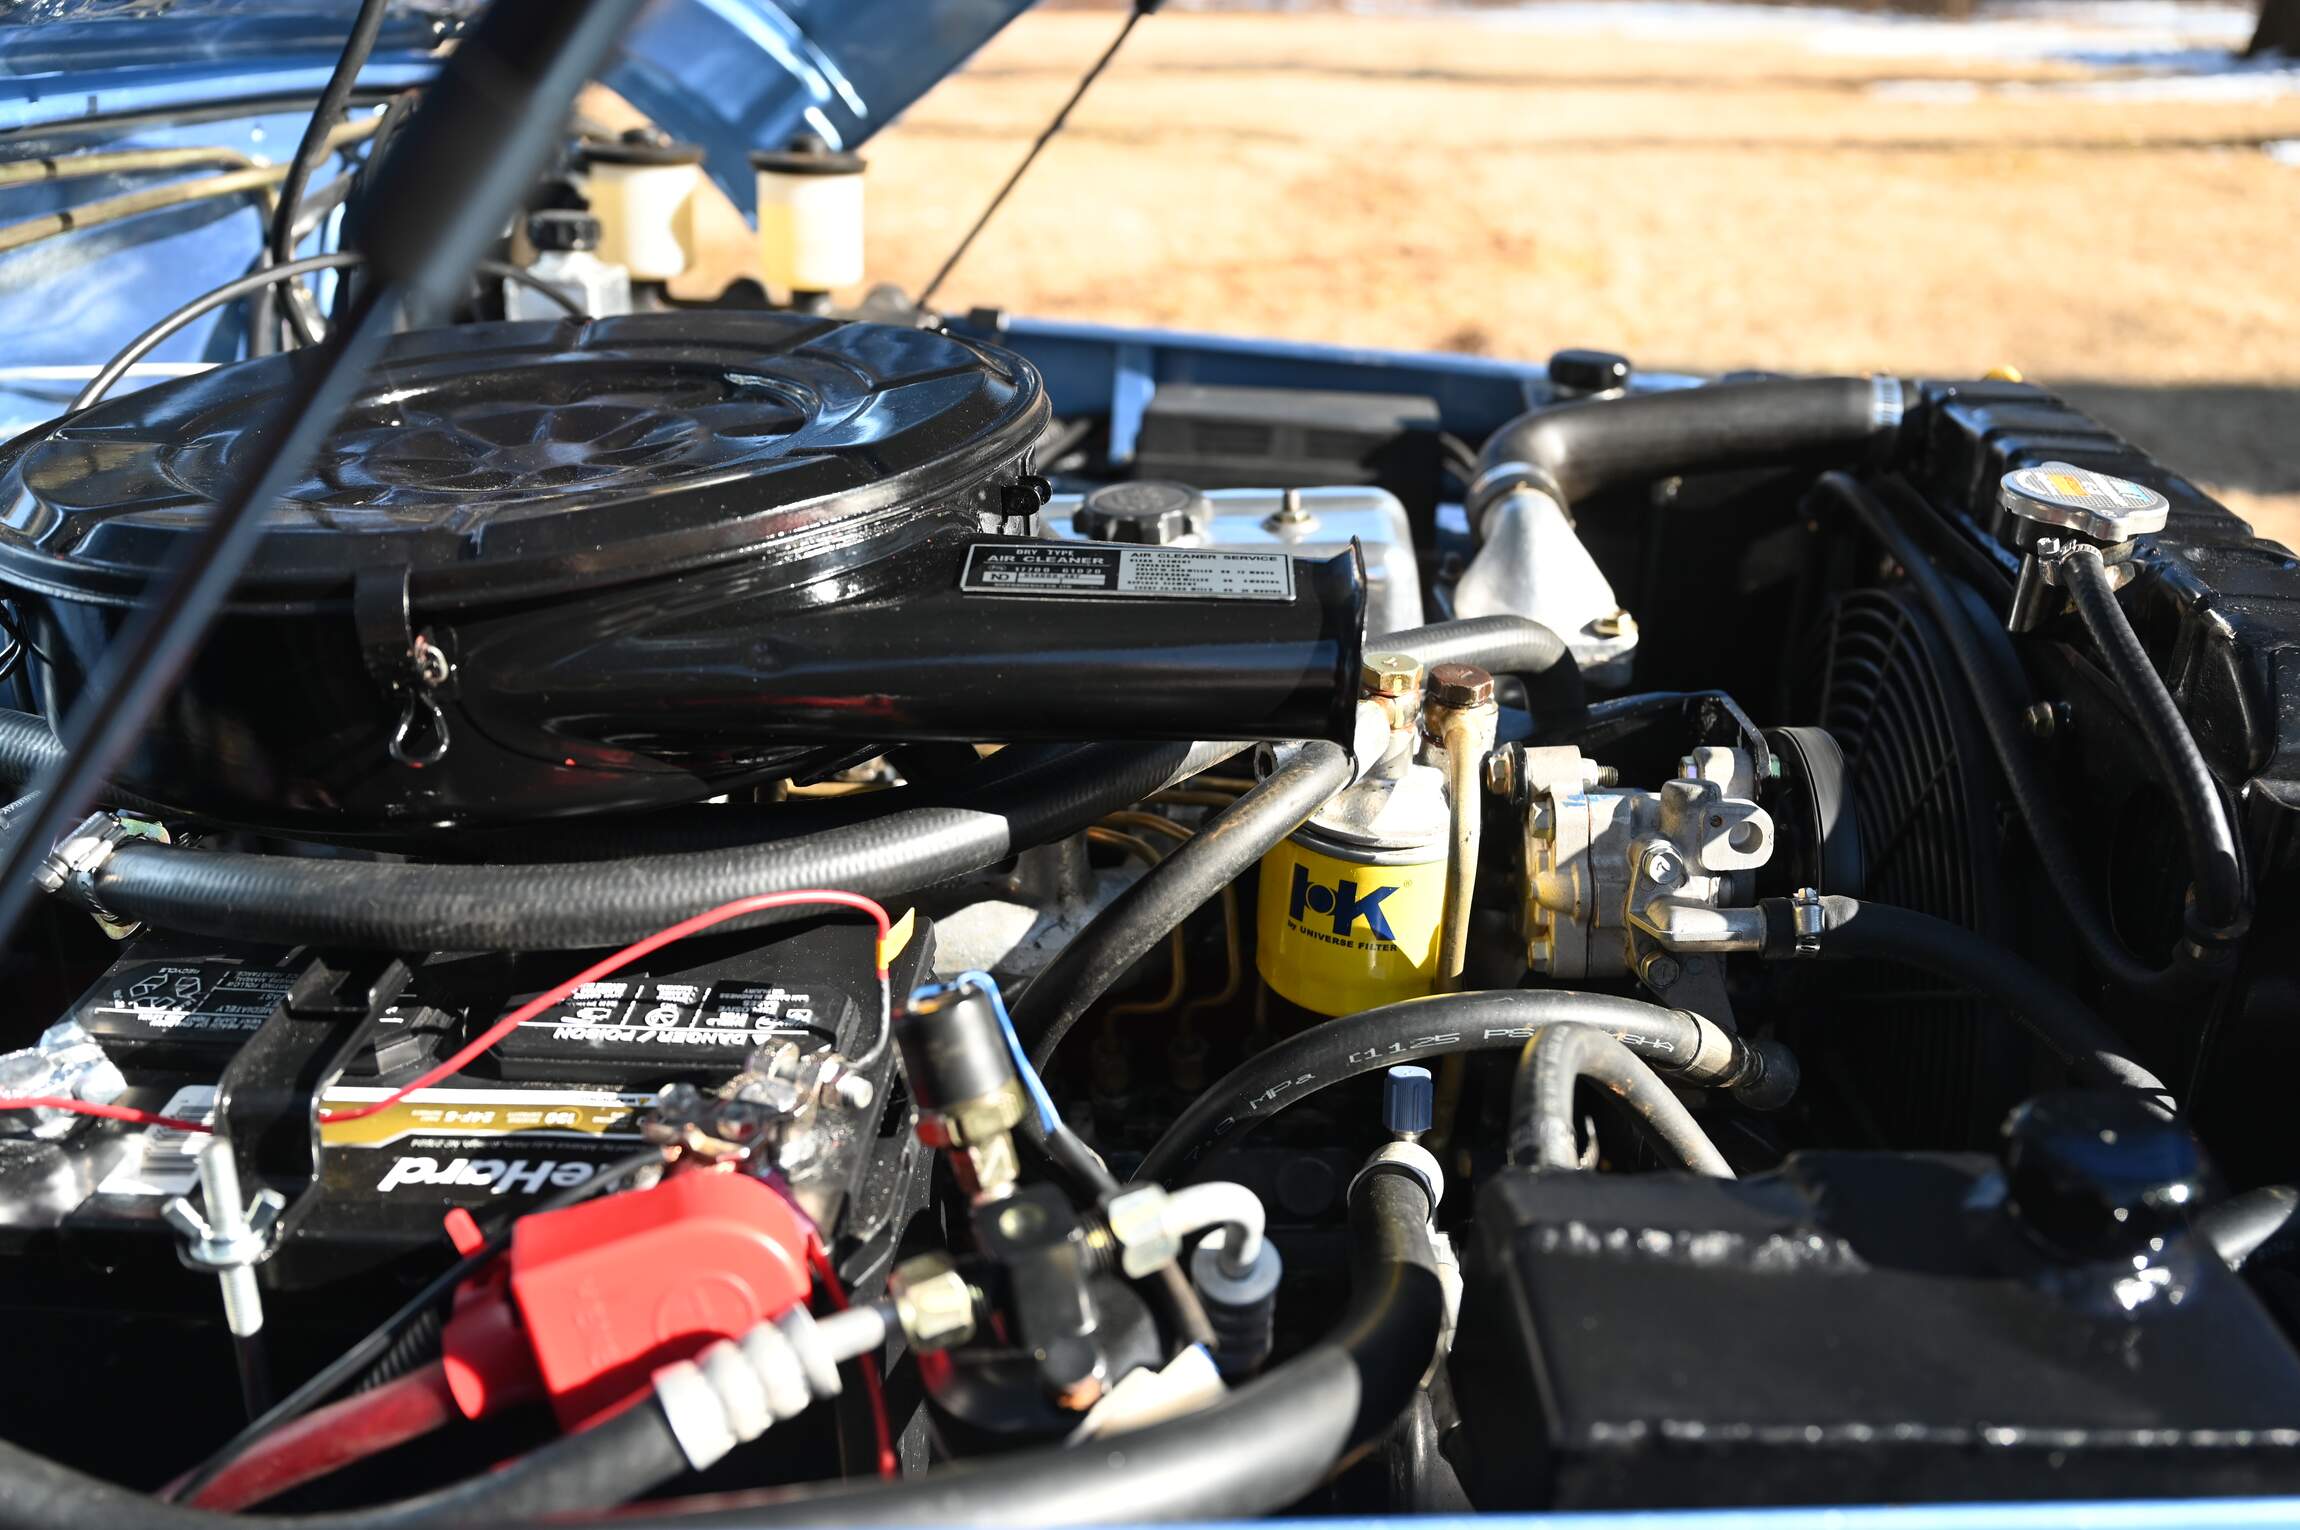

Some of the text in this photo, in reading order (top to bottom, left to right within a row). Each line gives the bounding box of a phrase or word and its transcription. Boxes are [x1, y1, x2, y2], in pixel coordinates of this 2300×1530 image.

[1022, 556, 1105, 564] CLEANER
[1047, 549, 1075, 557] TYPE
[1287, 919, 1398, 952] by UNIVERSE FILTER
[553, 1027, 636, 1042] POISON
[657, 1031, 748, 1045] DANGER
[1250, 1073, 1316, 1110] MPa
[1483, 1028, 1536, 1040] PS
